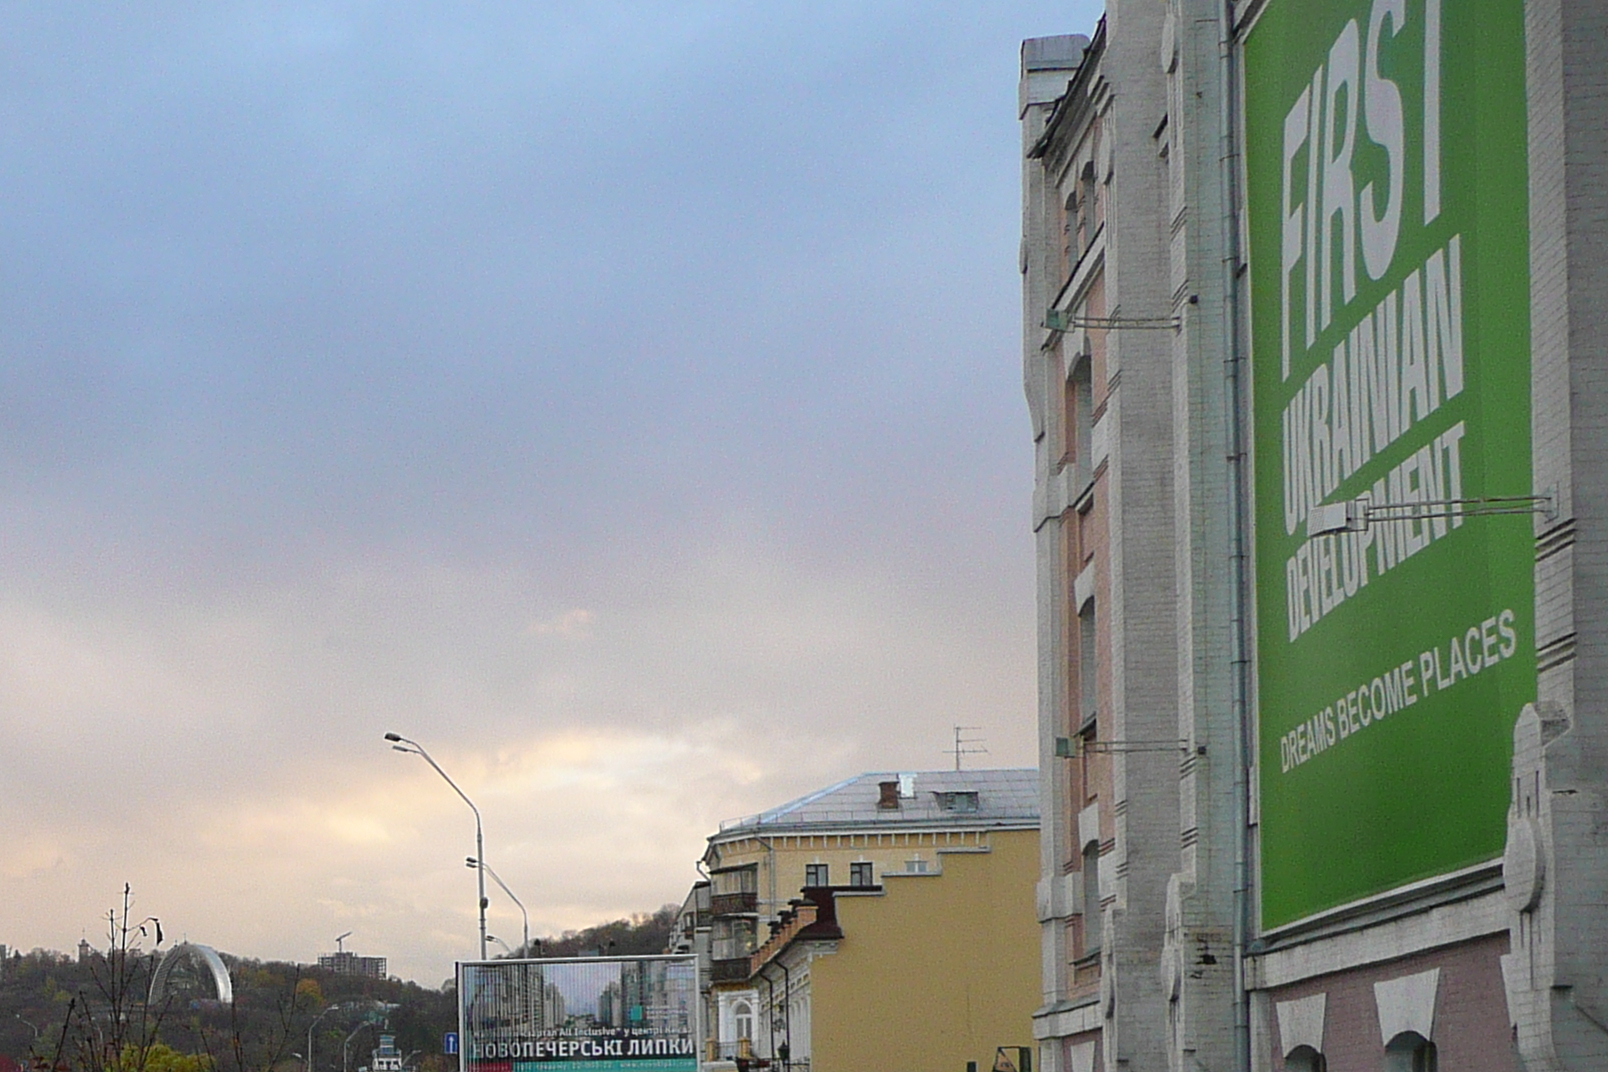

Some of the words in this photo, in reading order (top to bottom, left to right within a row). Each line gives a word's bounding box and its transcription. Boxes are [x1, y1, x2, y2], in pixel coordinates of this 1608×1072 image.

[1282, 233, 1464, 536] UKRAINIAN
[1286, 420, 1466, 643] DEVELOPMENT
[1280, 706, 1336, 774] DREAMS
[1337, 660, 1418, 740] BECOME
[1420, 608, 1517, 697] PLACES
[473, 1039, 623, 1059] НОВОПЕЧЕРСЬКІ
[627, 1038, 694, 1056] ЛИПКИ
